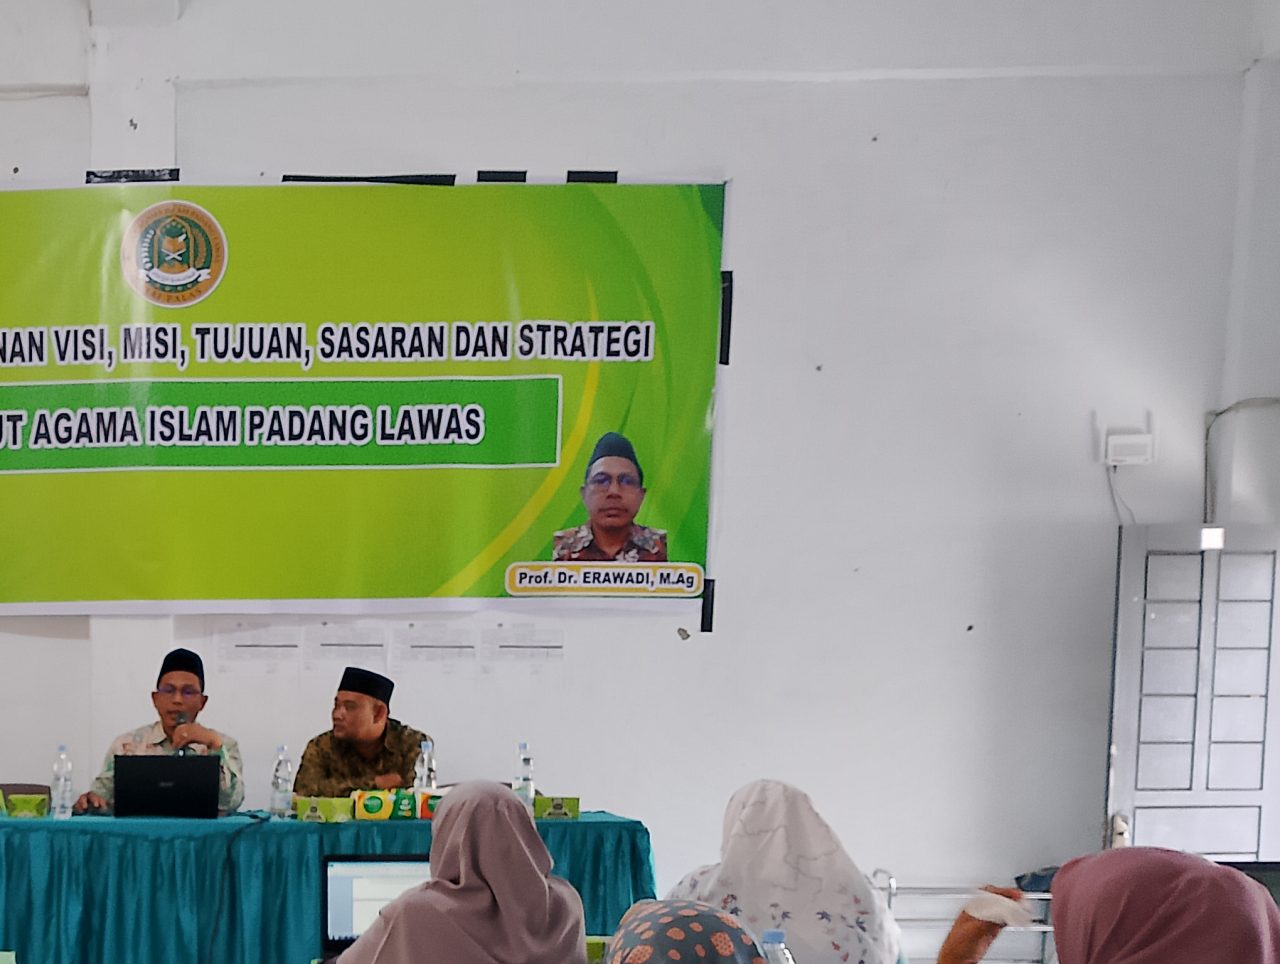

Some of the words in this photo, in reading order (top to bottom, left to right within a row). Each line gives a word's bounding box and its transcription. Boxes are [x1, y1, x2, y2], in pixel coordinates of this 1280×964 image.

[54, 328, 114, 368] VISI,
[123, 326, 186, 367] MISI,
[195, 326, 310, 367] TUJUAN,
[319, 325, 445, 359] SASARAN
[455, 325, 509, 358] DAN
[518, 323, 652, 359] STRATEGI
[33, 410, 139, 445] AGAMA
[149, 410, 238, 442] ISLAM
[249, 409, 369, 442] PADANG
[380, 408, 482, 441] LAWAS
[518, 571, 553, 585] Prof.
[557, 571, 578, 584] Dr.
[582, 571, 655, 587] ERAWADI,
[659, 572, 695, 589] M.Ag
